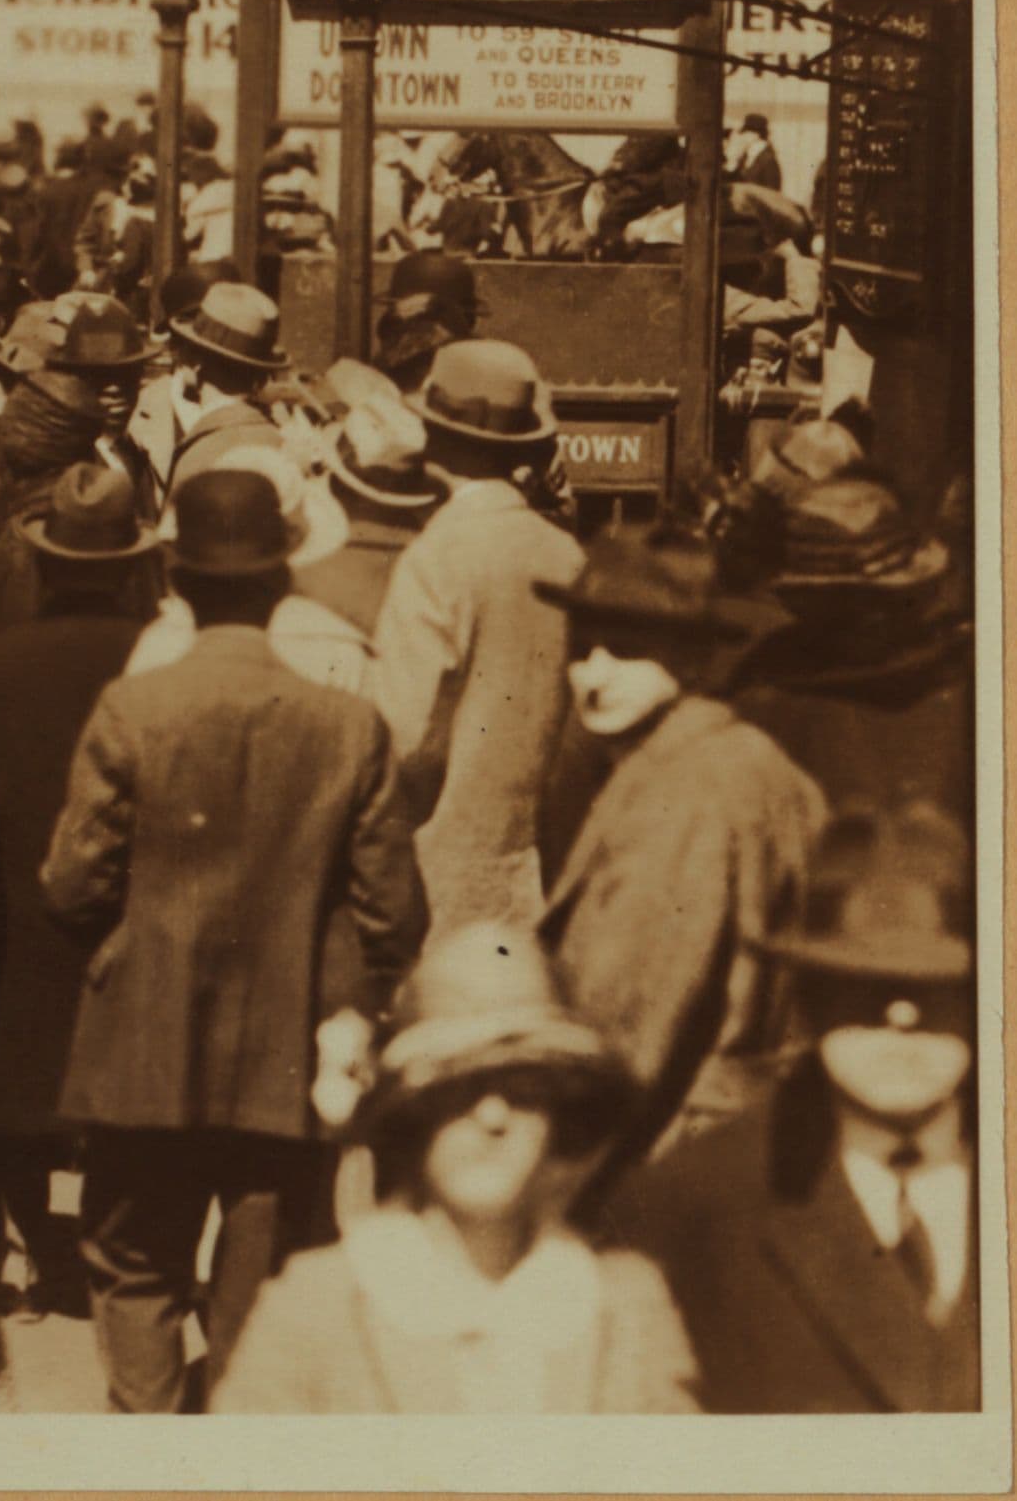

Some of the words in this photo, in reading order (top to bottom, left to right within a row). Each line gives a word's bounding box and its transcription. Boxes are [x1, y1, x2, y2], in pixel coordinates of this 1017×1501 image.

[13, 25, 137, 59] STORE
[319, 19, 429, 60] UOWN
[475, 49, 510, 64] AND
[518, 46, 622, 67] QUEENS
[310, 70, 460, 107] DONTOWN
[490, 71, 518, 89] TO
[526, 72, 585, 91] SOUTH
[590, 73, 647, 93] FERRY
[495, 94, 526, 110] AND
[534, 90, 633, 112] BROOKLYN
